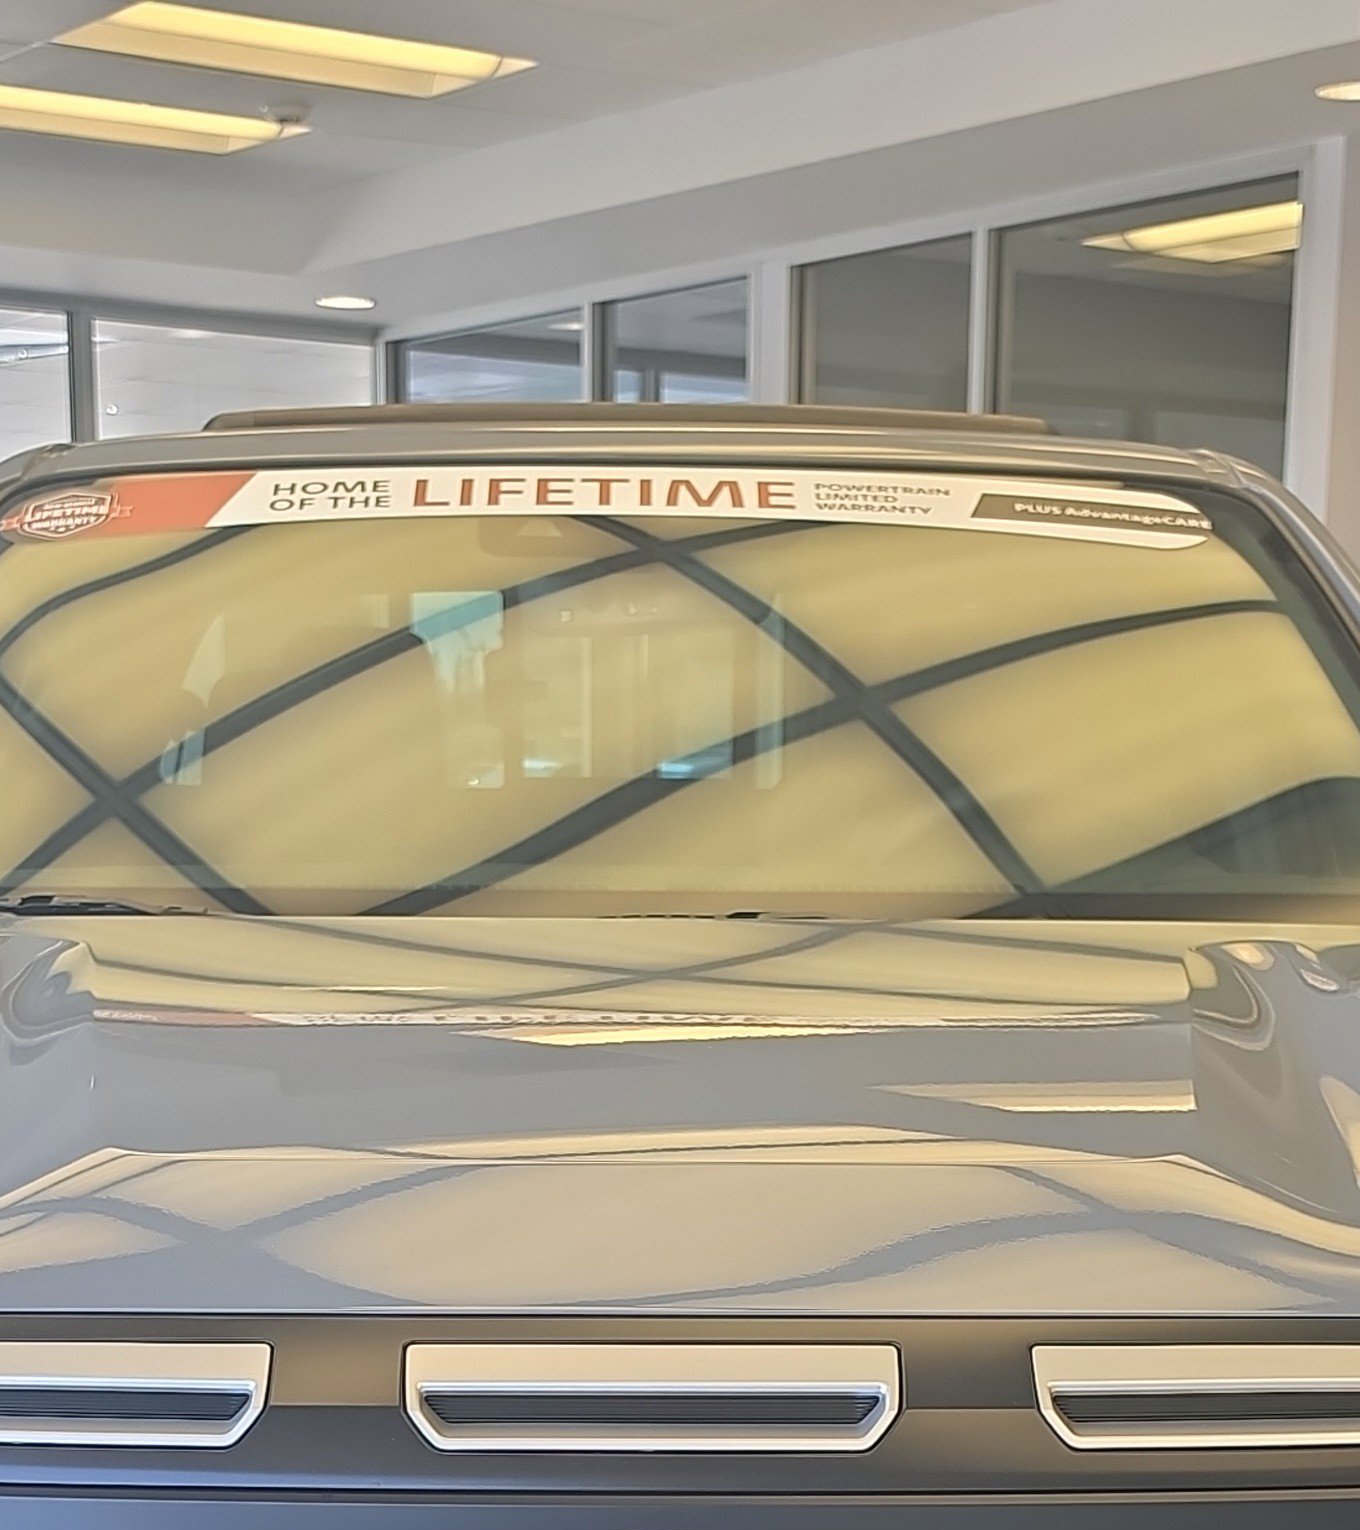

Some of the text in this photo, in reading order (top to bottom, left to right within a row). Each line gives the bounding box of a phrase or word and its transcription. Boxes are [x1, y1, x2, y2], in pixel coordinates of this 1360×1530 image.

[272, 479, 391, 496] HOME
[413, 478, 796, 510] LIFETIME
[814, 482, 951, 497] POWERTRAIN
[269, 495, 392, 511] OF THE
[814, 492, 898, 503] LIMITED
[814, 502, 932, 515] WARRANTY
[1013, 502, 1062, 515] PLUS
